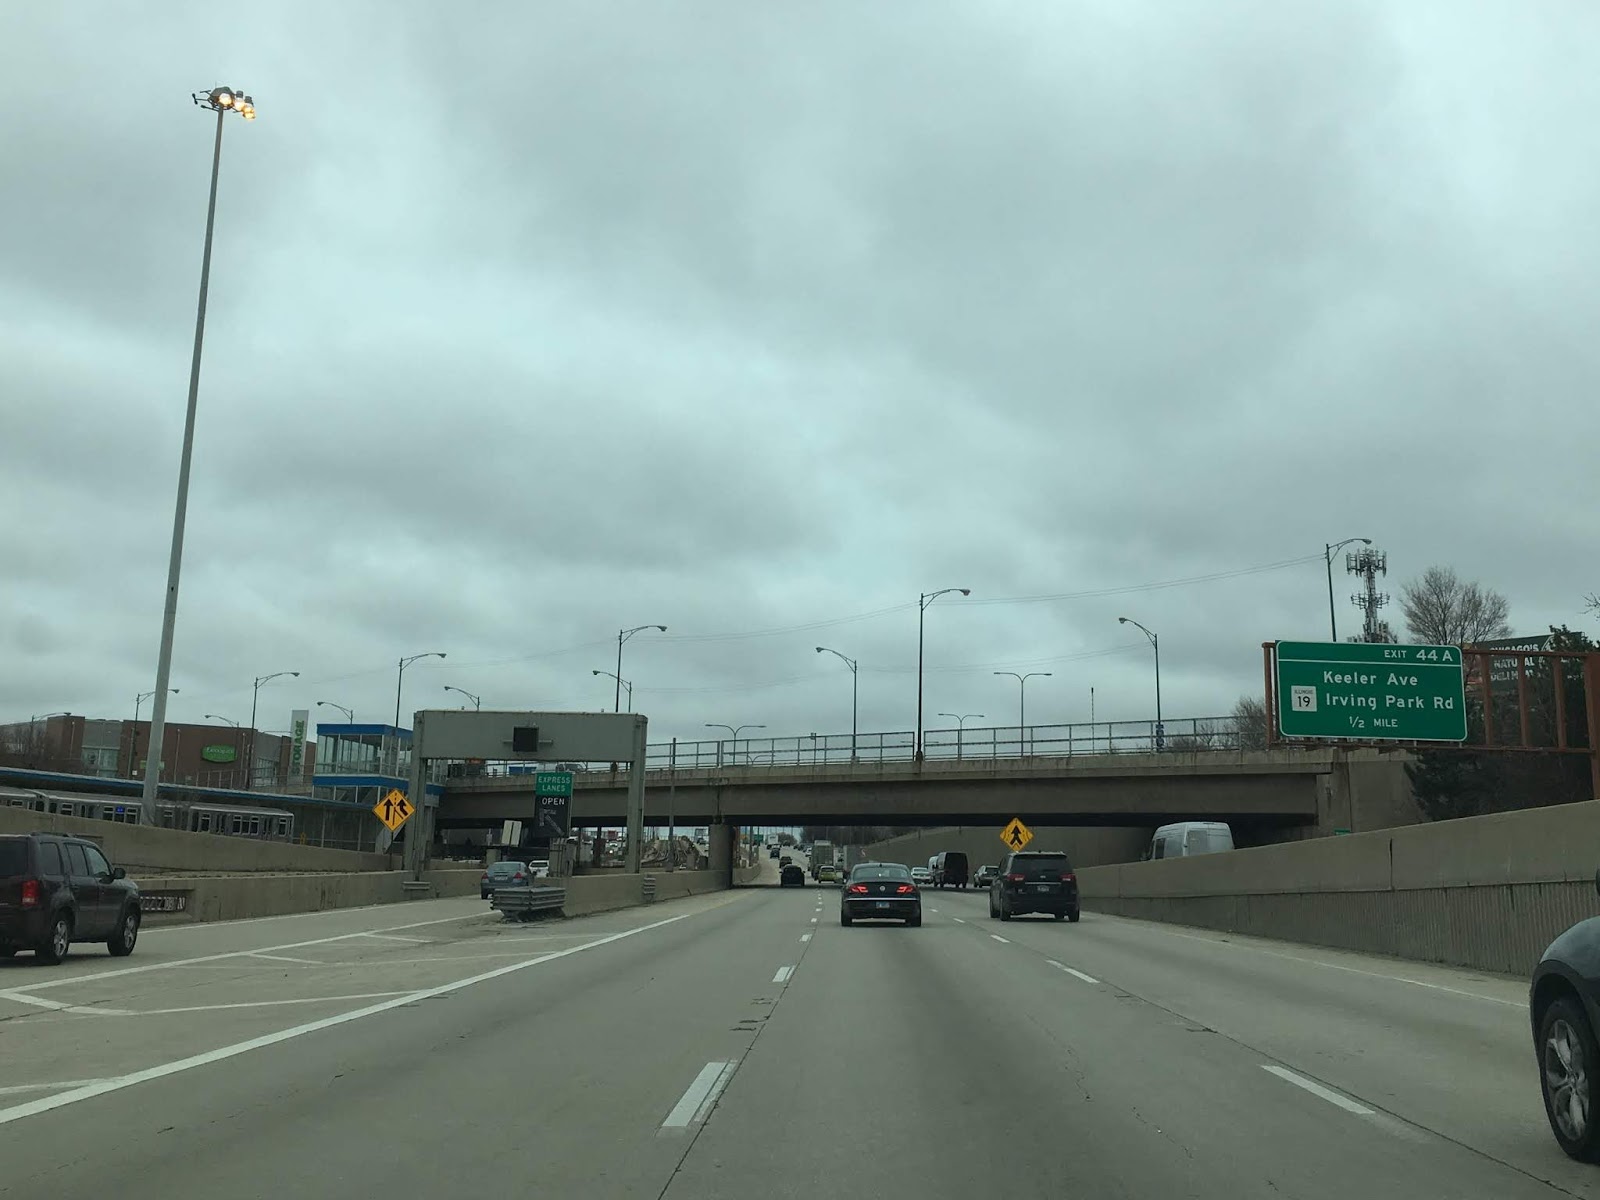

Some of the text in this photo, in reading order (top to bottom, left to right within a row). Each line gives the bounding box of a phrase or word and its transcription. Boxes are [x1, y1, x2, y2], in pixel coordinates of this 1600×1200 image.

[1384, 650, 1407, 659] EXIT
[1494, 656, 1535, 669] NATUAL
[1323, 671, 1418, 686] Keeler Ave
[1297, 695, 1311, 708] 19
[1326, 693, 1454, 711] Irving Park Rd
[1373, 718, 1399, 728] MILE
[538, 776, 571, 784] EXPRESS
[542, 784, 566, 792] LANES
[541, 797, 565, 806] OPEN
